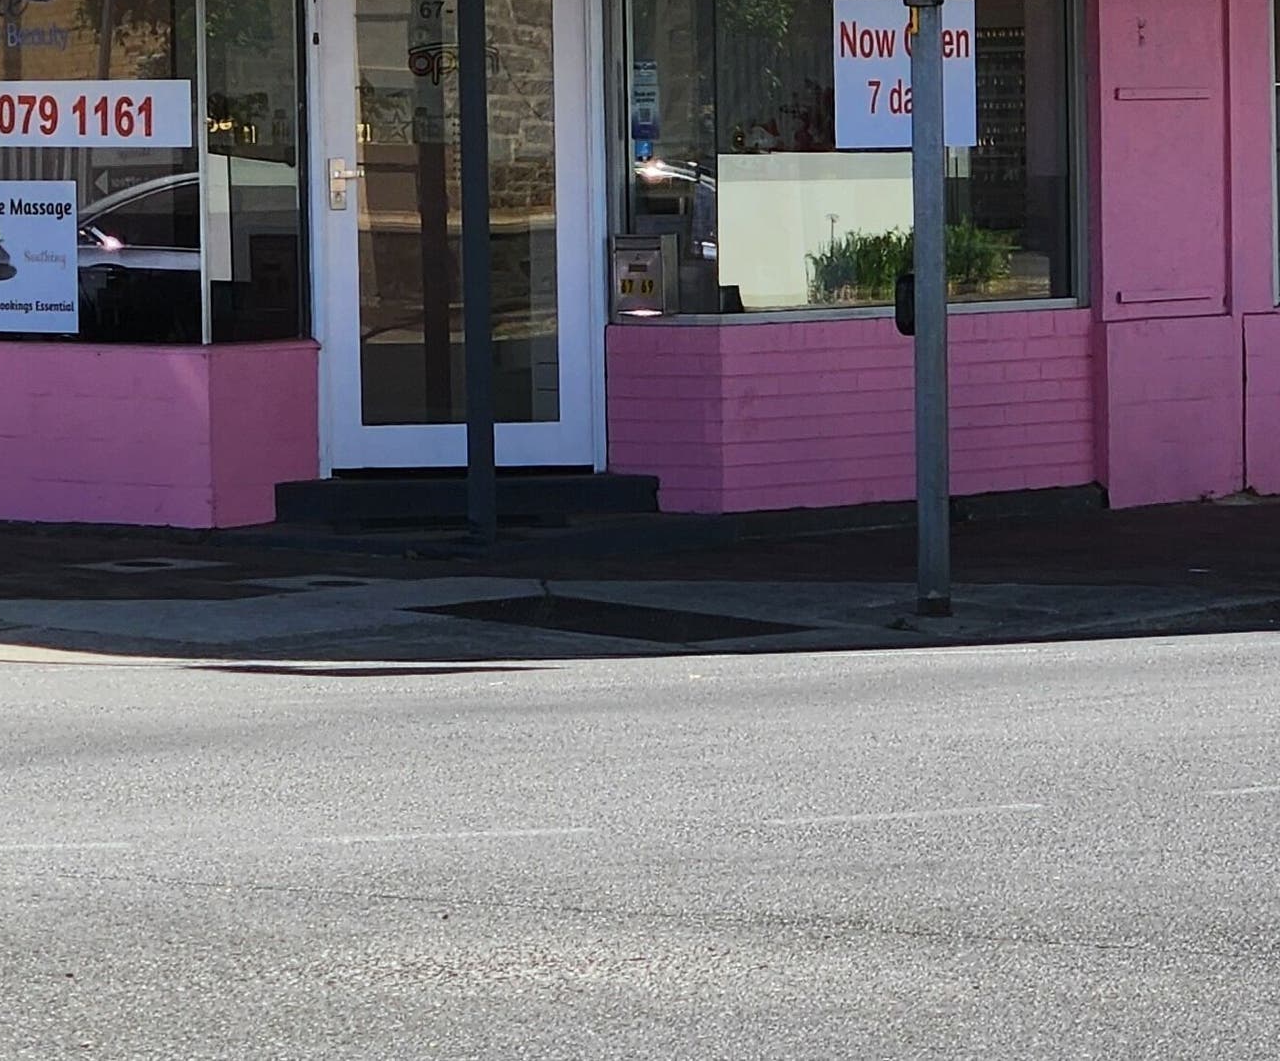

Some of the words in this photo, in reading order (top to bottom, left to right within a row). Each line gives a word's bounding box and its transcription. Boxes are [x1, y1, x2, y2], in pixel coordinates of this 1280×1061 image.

[420, 0, 454, 19] 67-
[841, 21, 896, 58] Now
[904, 23, 969, 58] en
[409, 50, 499, 86] opn
[868, 80, 881, 114] 7
[889, 79, 913, 114] da
[72, 95, 152, 136] 1161
[10, 198, 72, 219] Massage
[35, 300, 74, 313] Essential
